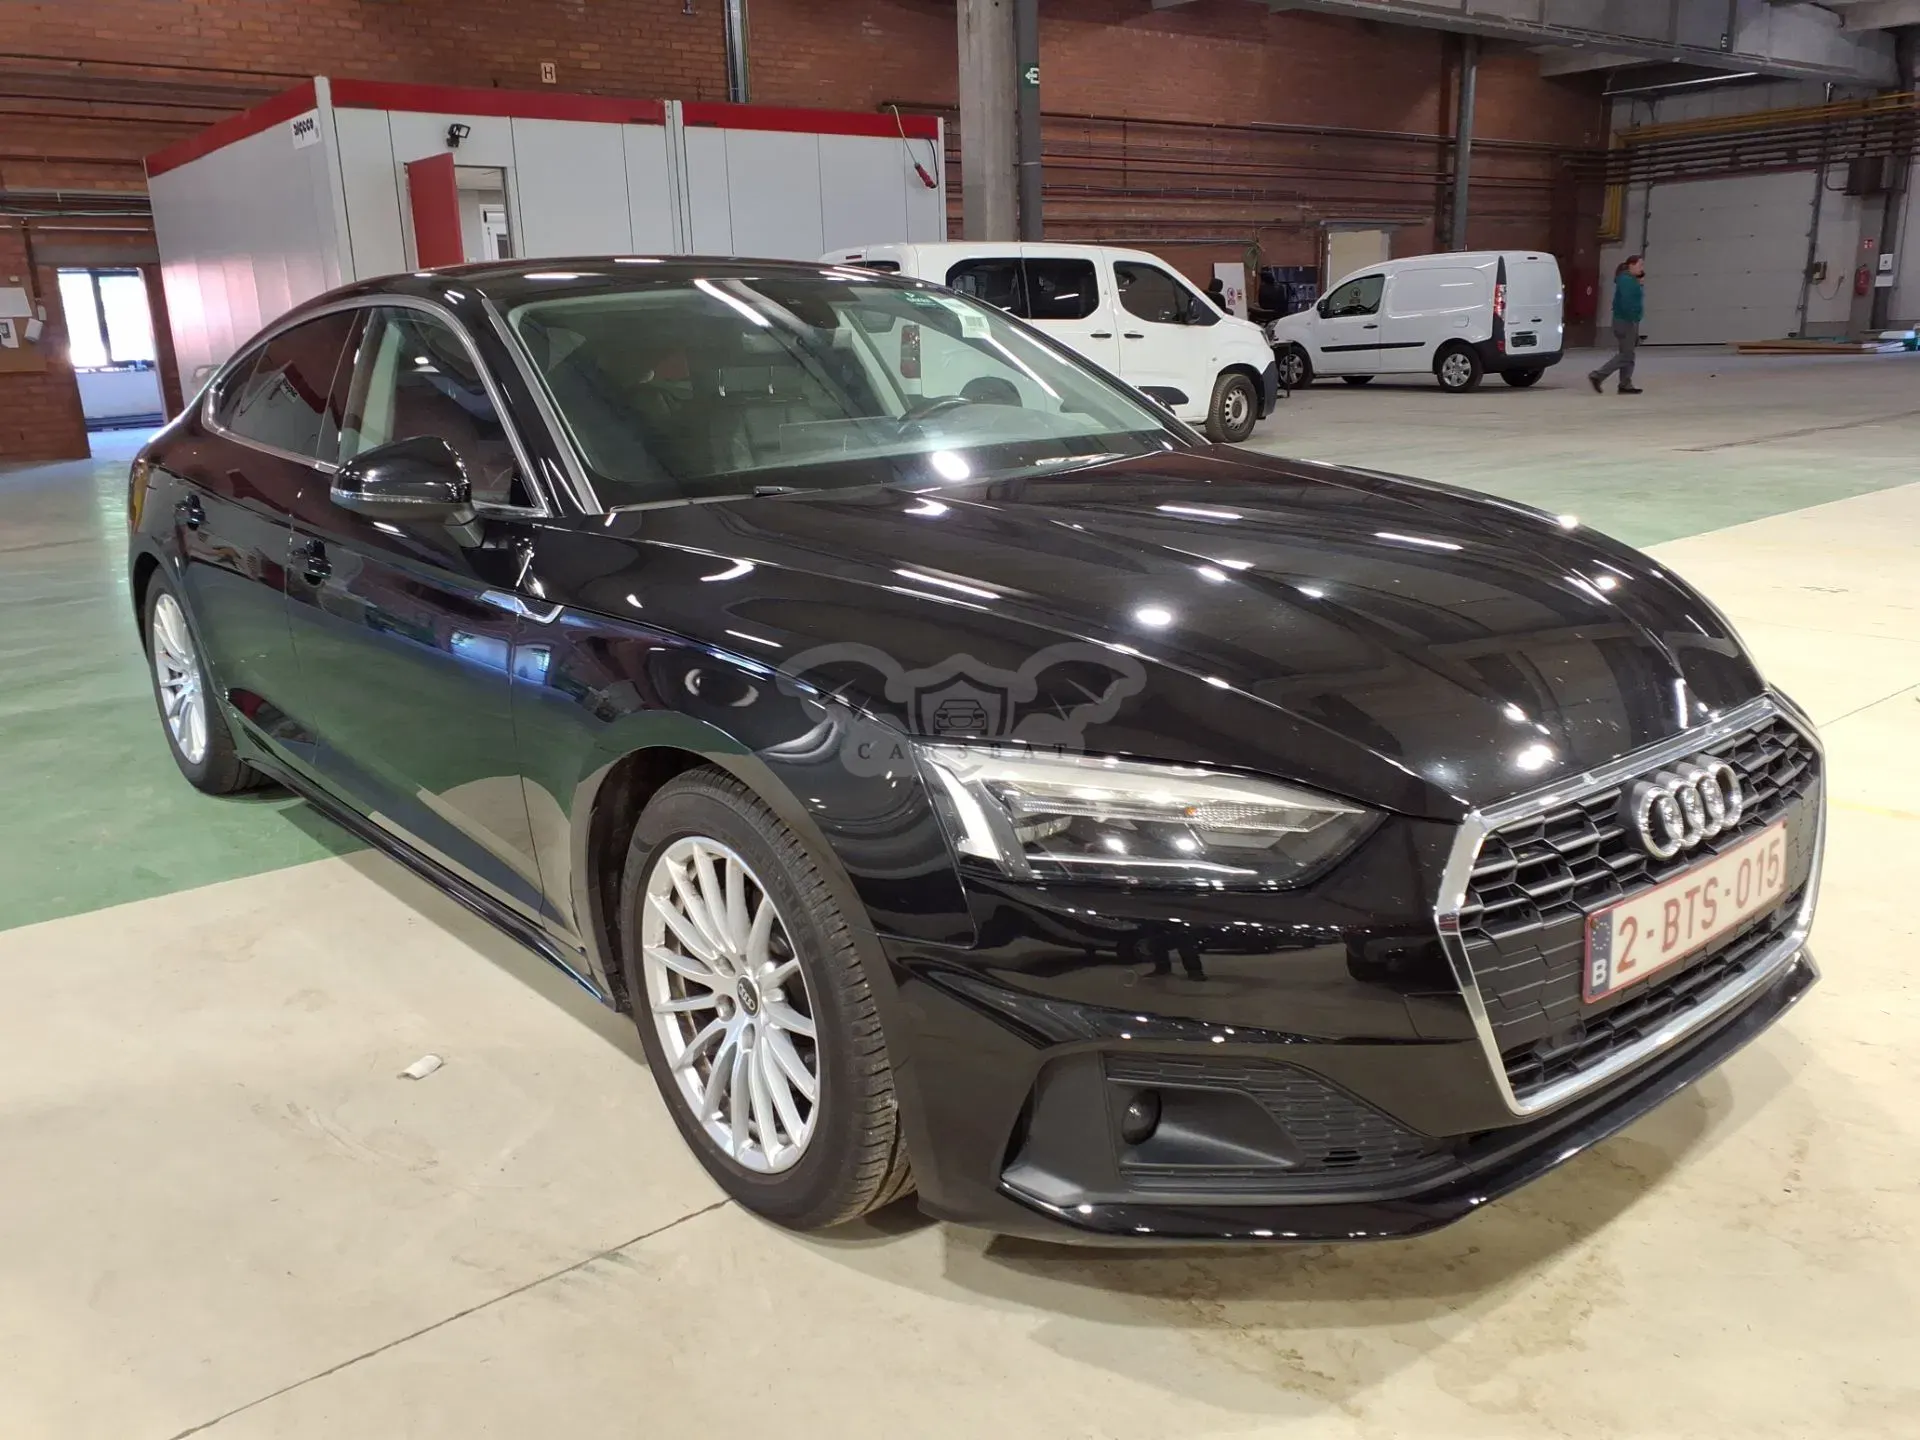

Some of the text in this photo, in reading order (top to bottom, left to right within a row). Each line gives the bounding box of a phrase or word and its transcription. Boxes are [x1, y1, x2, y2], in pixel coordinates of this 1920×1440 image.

[543, 65, 554, 81] H
[1616, 838, 1781, 973] 2-BTS-015
[1591, 958, 1607, 987] B
